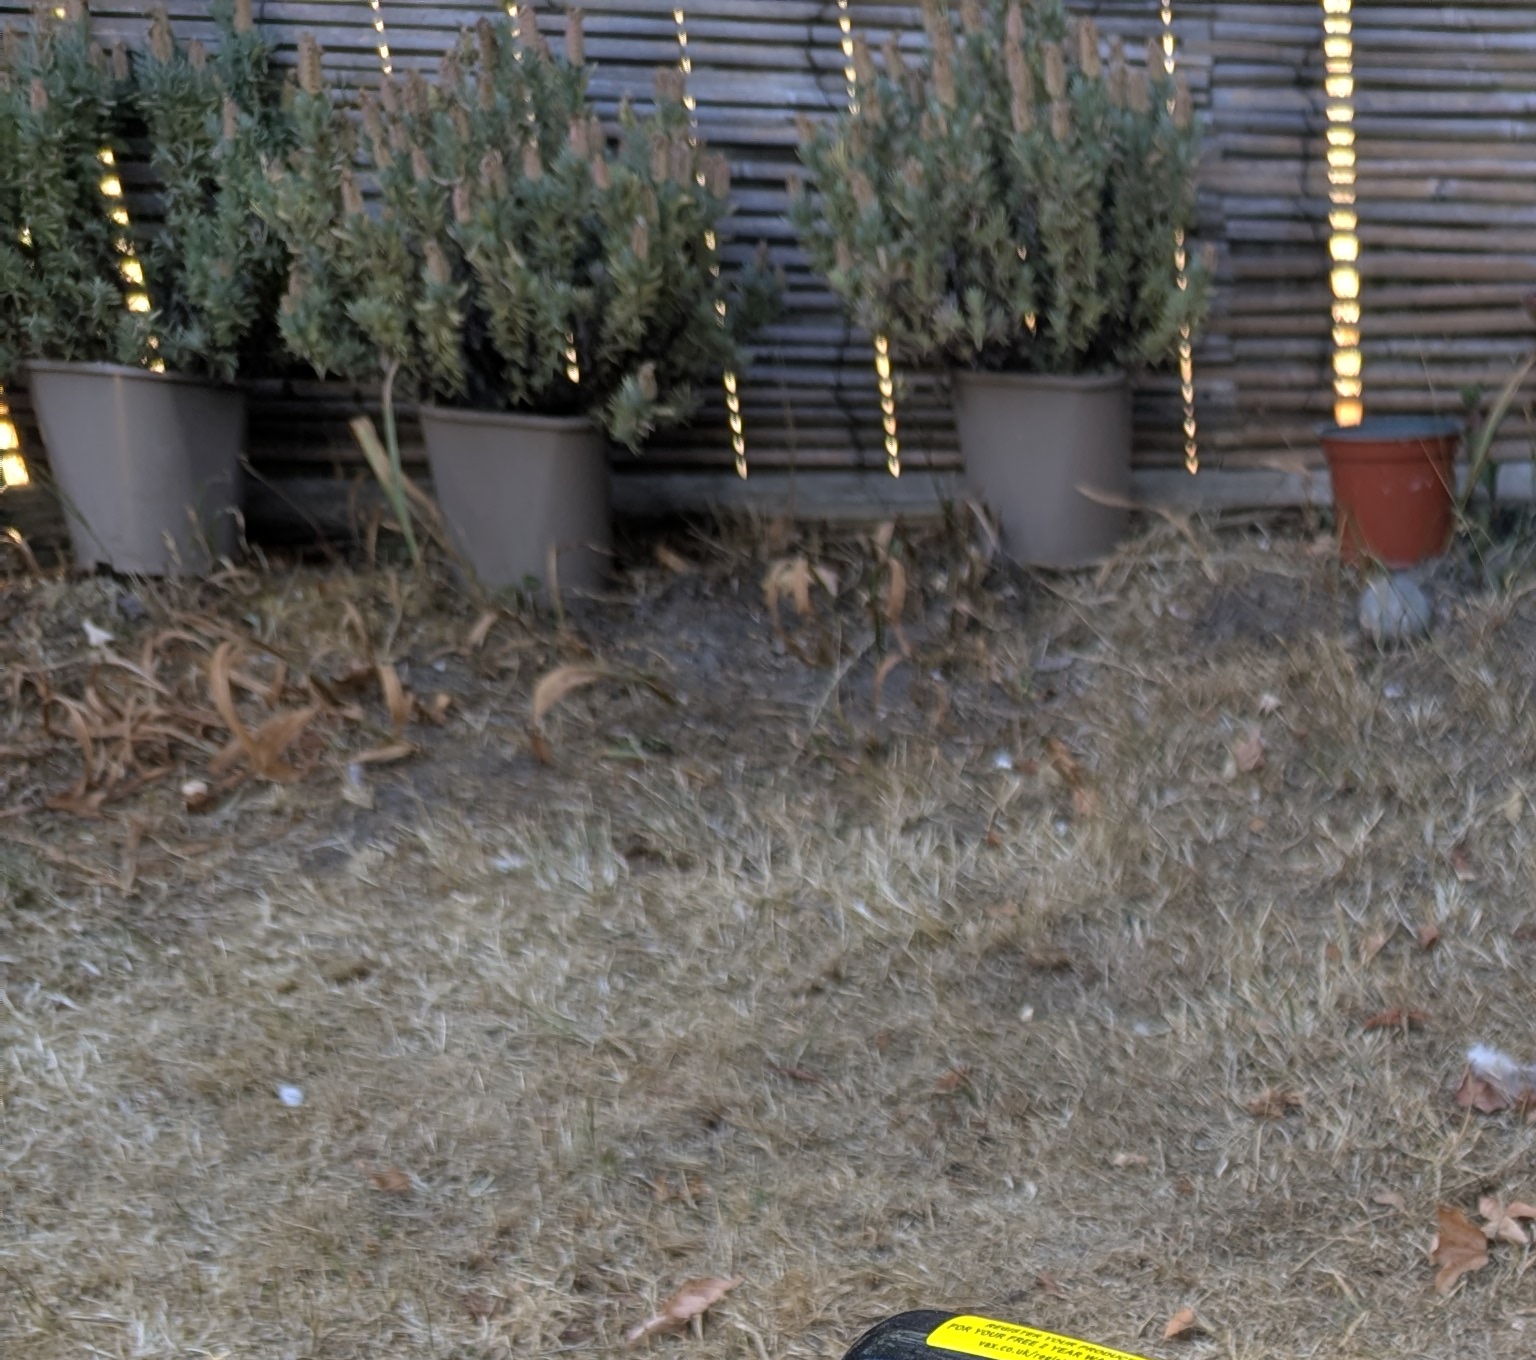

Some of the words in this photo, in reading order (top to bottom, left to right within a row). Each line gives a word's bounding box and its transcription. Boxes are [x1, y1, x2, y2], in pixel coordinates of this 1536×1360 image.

[947, 1323, 972, 1333] FOR
[975, 1328, 1006, 1340] YOUR
[1007, 1336, 1039, 1347] FREE
[1051, 1345, 1083, 1358] YEAR
